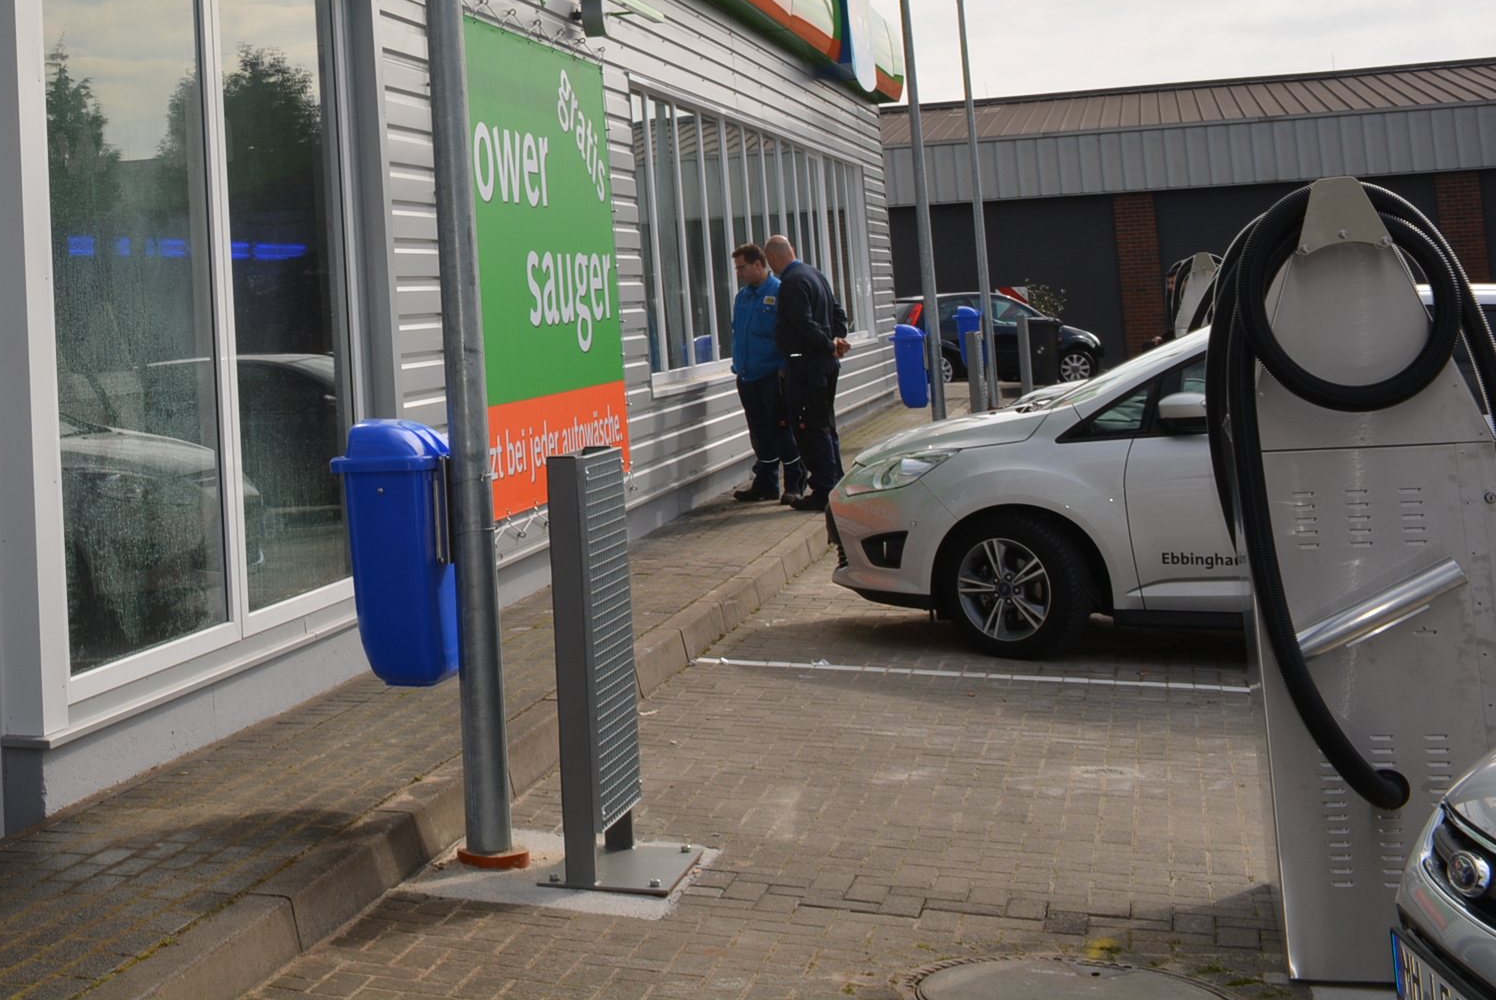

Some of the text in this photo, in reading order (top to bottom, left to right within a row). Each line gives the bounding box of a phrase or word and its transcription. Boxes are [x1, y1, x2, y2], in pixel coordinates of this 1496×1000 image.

[473, 120, 549, 208] ower
[556, 68, 606, 203] gratis
[526, 250, 612, 353] sauger
[505, 429, 527, 476] bei
[530, 420, 559, 484] jeder
